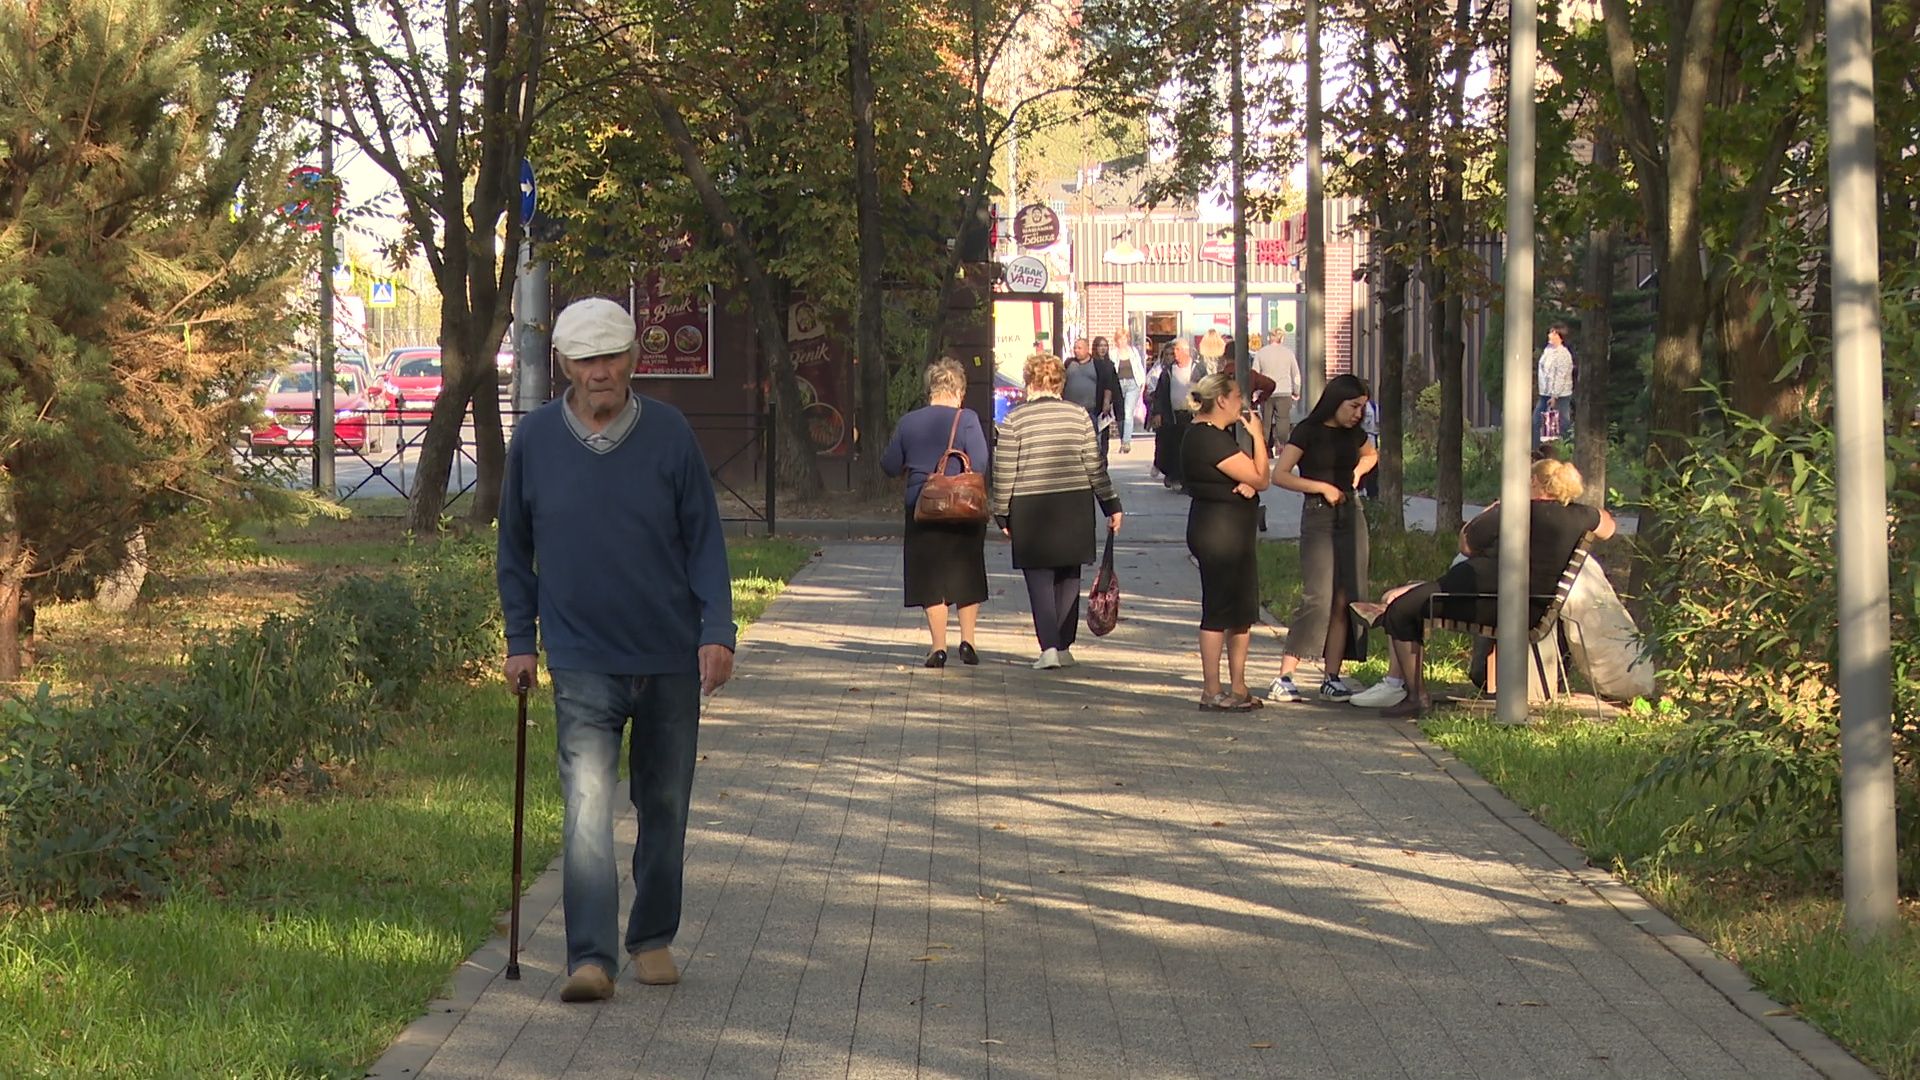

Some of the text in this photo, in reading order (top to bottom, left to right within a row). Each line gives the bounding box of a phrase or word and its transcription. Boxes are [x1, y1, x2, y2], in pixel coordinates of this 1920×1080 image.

[1147, 240, 1192, 264] ХЛЕБ
[1011, 271, 1042, 288] VAPE
[1013, 264, 1043, 278] ТАБАК
[652, 298, 692, 324] Benik
[996, 334, 1020, 343] ТИКА
